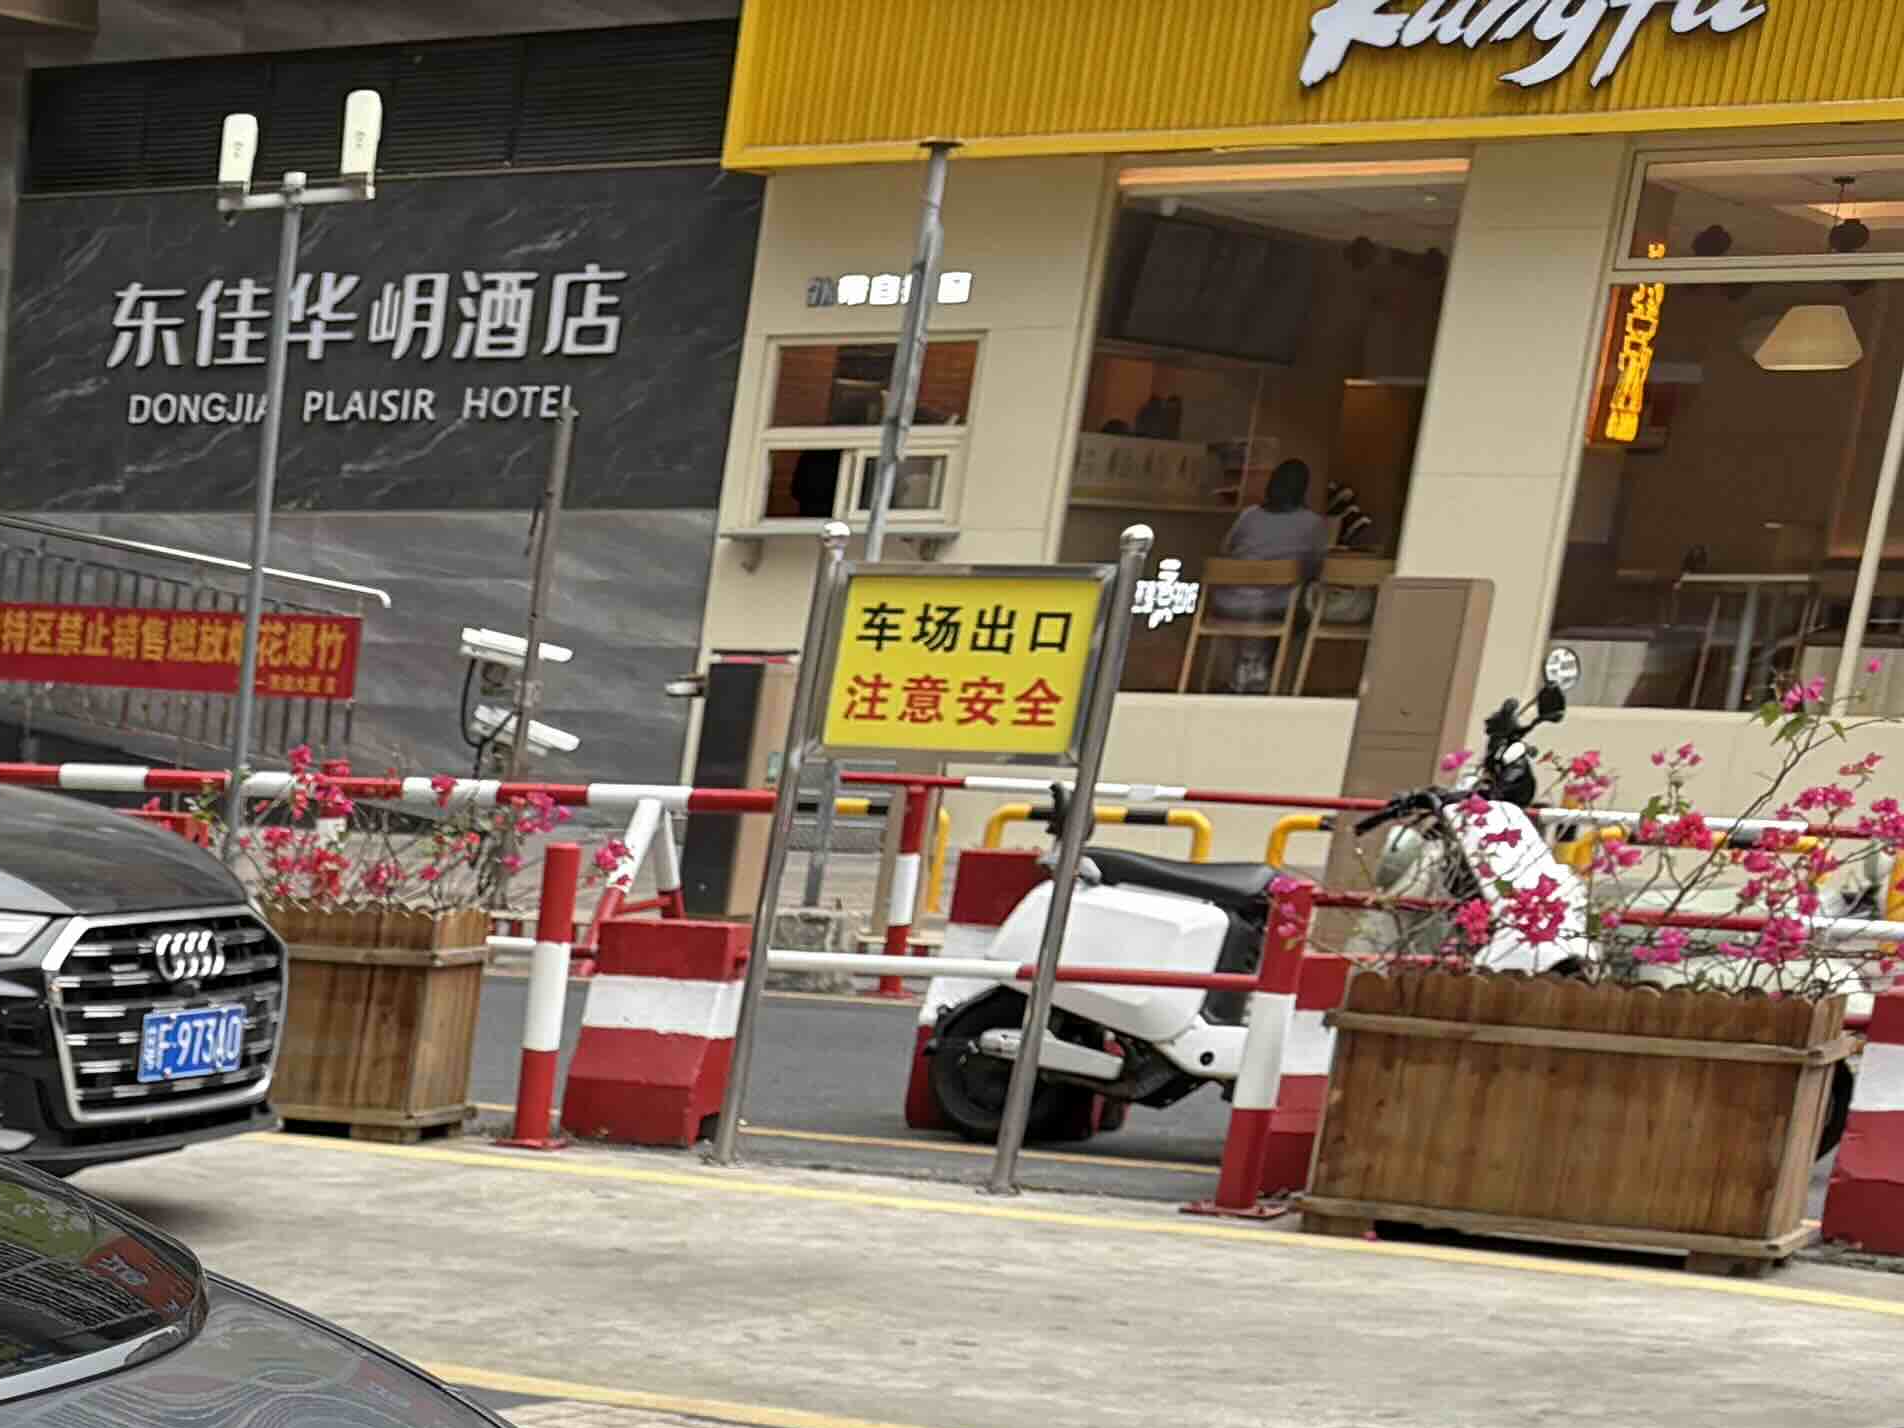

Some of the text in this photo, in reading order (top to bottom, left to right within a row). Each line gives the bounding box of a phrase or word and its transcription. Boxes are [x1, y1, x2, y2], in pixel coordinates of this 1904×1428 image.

[302, 387, 437, 423] PLAISIR
[462, 384, 580, 420] HOTEL
[856, 601, 1073, 655] 车场出口
[843, 673, 1063, 728] 注意安全
